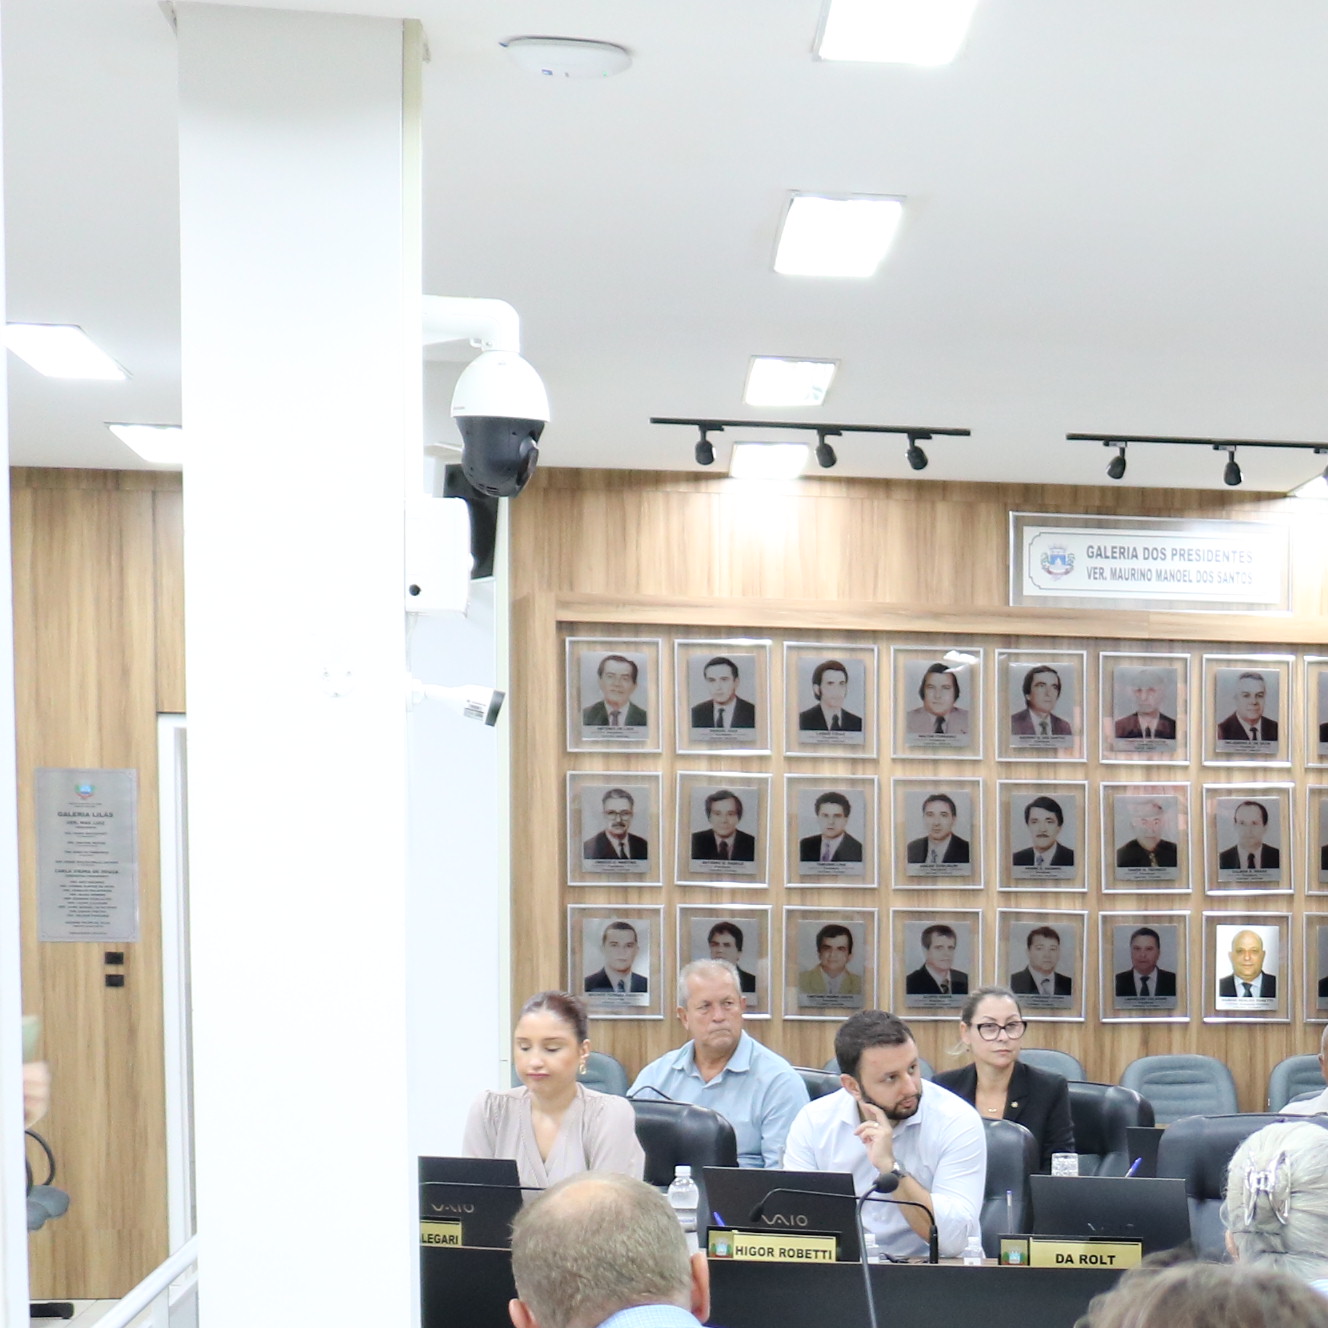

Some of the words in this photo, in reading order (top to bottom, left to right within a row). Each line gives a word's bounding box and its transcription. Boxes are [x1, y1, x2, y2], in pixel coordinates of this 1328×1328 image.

[1086, 545, 1139, 560] GALERIA
[1143, 547, 1167, 561] DOS
[1171, 548, 1253, 563] PRESIDENTES
[1087, 566, 1107, 581] VER.
[1110, 568, 1153, 582] MAURINO
[1156, 569, 1193, 583] MANOEL
[1196, 570, 1214, 584] DOS
[761, 1214, 808, 1226] VAIO
[735, 1245, 775, 1258] HIGOR
[778, 1247, 833, 1260] ROBETTI
[1056, 1253, 1074, 1264] DA
[1079, 1254, 1116, 1265] ROLT
